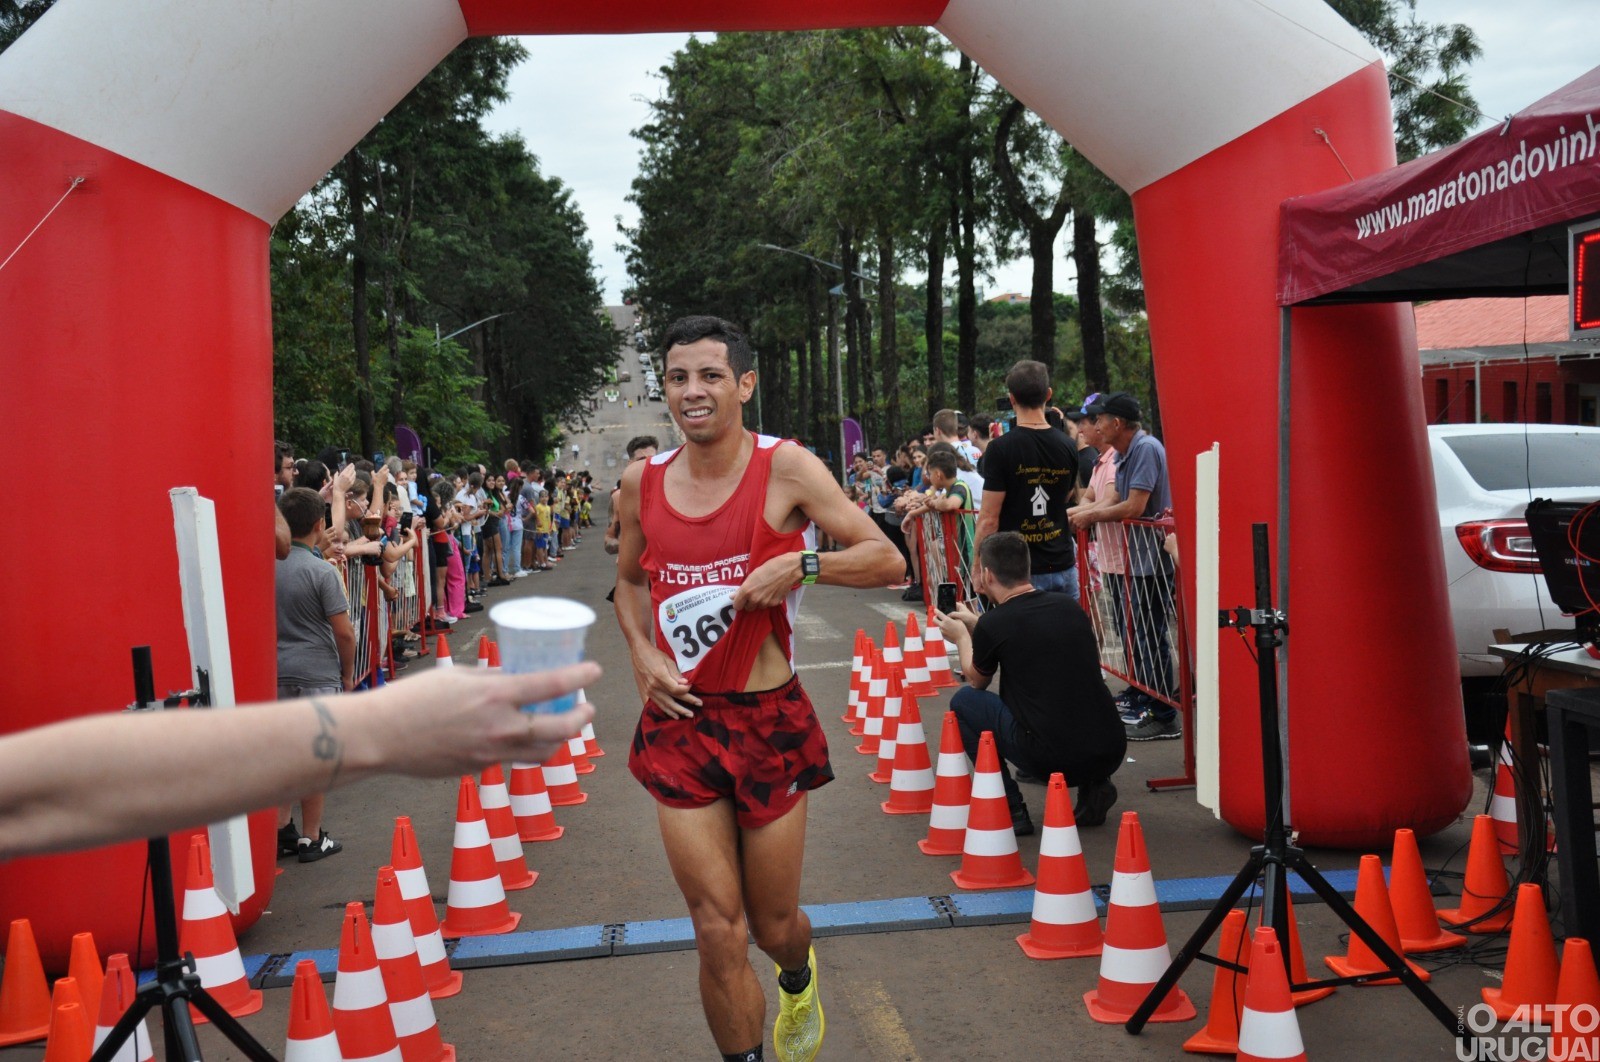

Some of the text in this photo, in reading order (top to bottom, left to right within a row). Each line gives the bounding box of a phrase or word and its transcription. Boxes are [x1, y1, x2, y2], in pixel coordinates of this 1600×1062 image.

[1018, 533, 1043, 543] ONTO
[666, 563, 713, 572] TREINAMENTO
[659, 563, 750, 585] FLORENA
